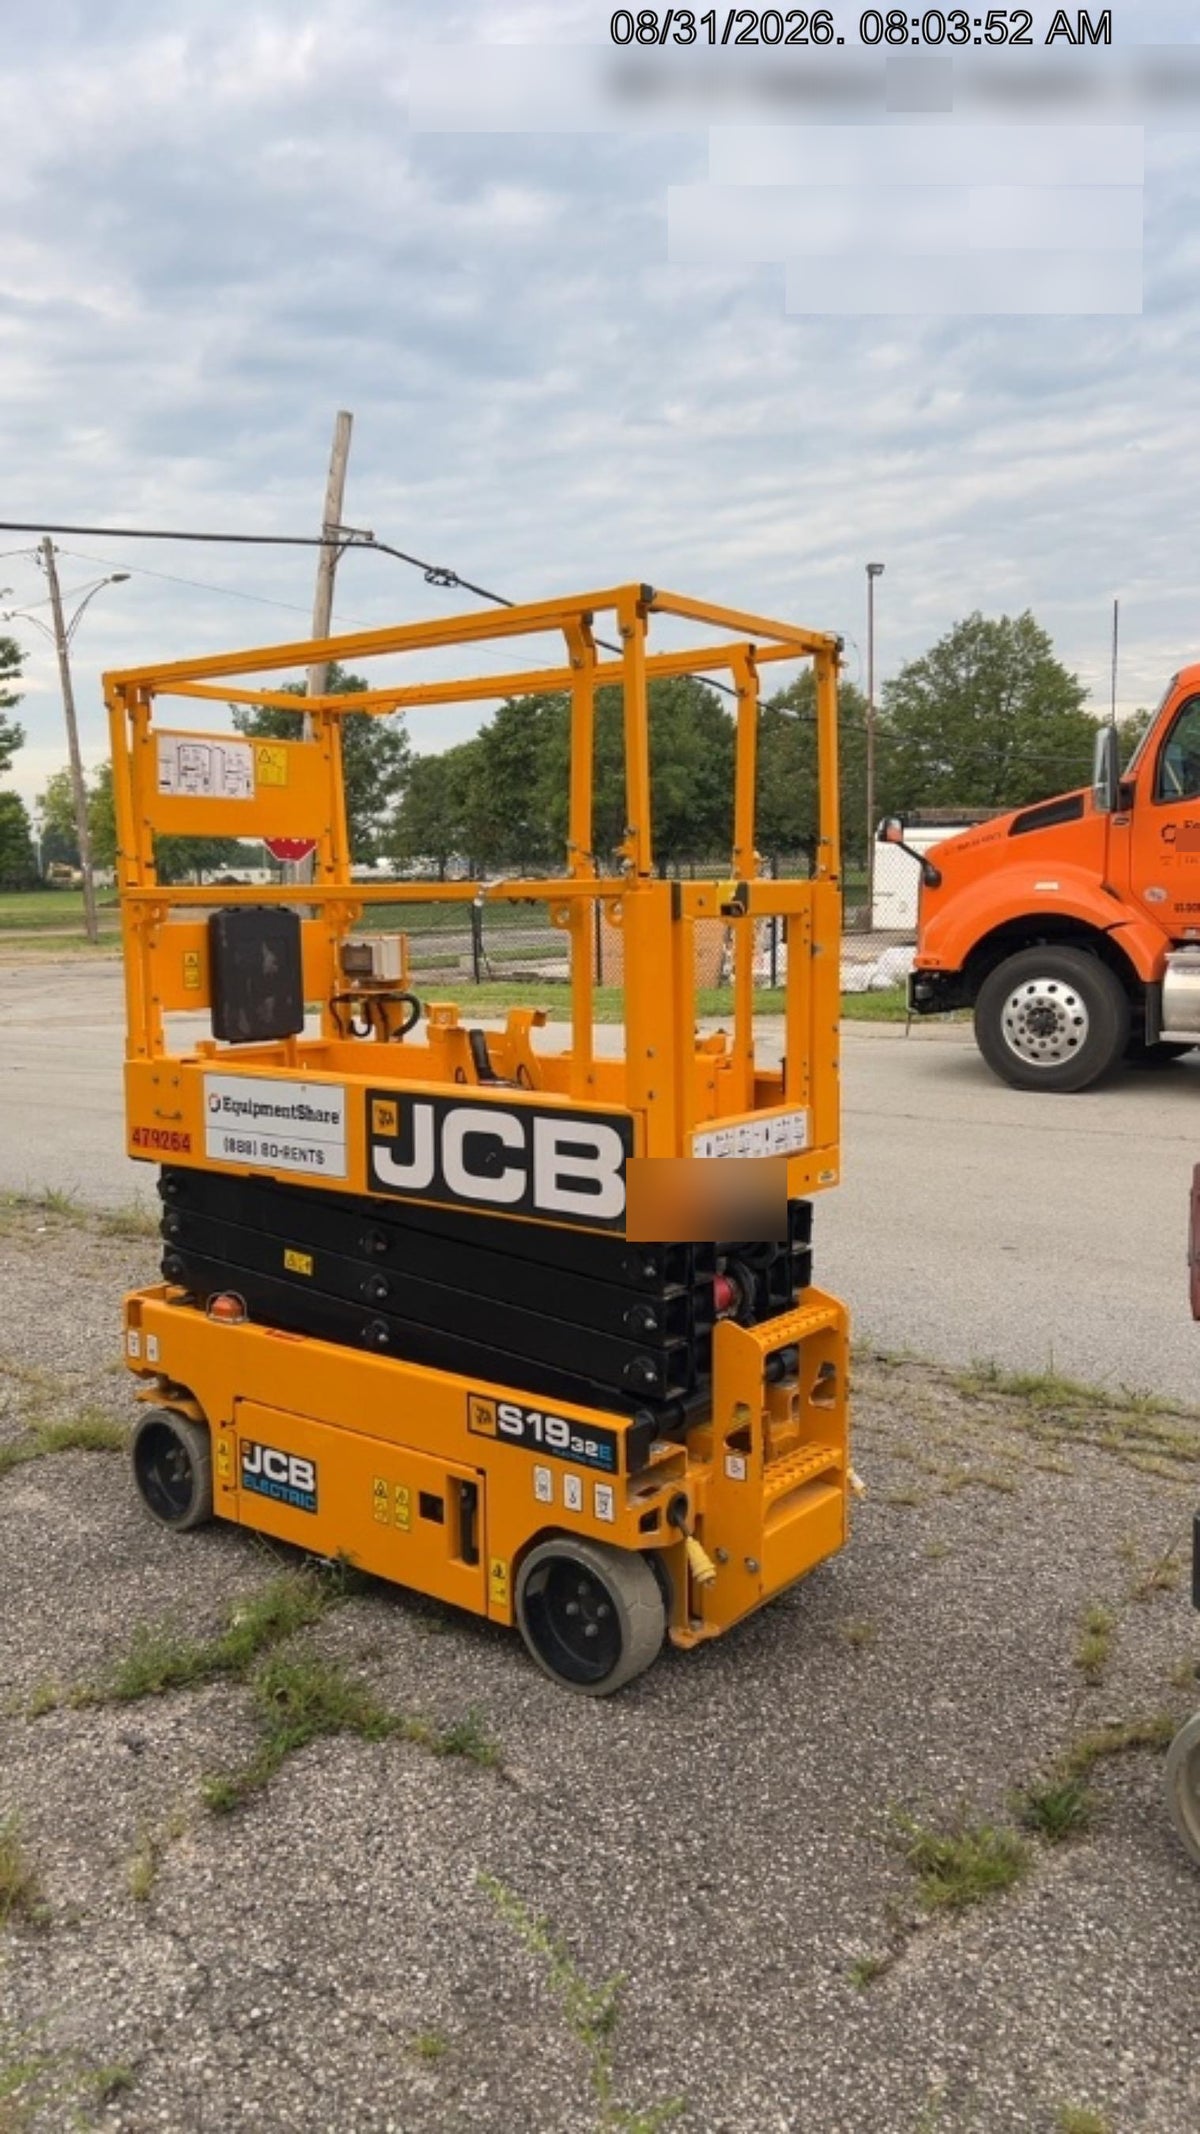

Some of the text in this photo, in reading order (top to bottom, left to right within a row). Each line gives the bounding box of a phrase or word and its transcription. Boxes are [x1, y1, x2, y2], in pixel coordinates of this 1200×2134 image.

[222, 1096, 340, 1125] EquipmentShare
[131, 1127, 191, 1153] 479264
[223, 1136, 257, 1156] (888)
[371, 1103, 626, 1220] JCB
[242, 1445, 315, 1493] JCB
[243, 1474, 317, 1511] ELECTRIC
